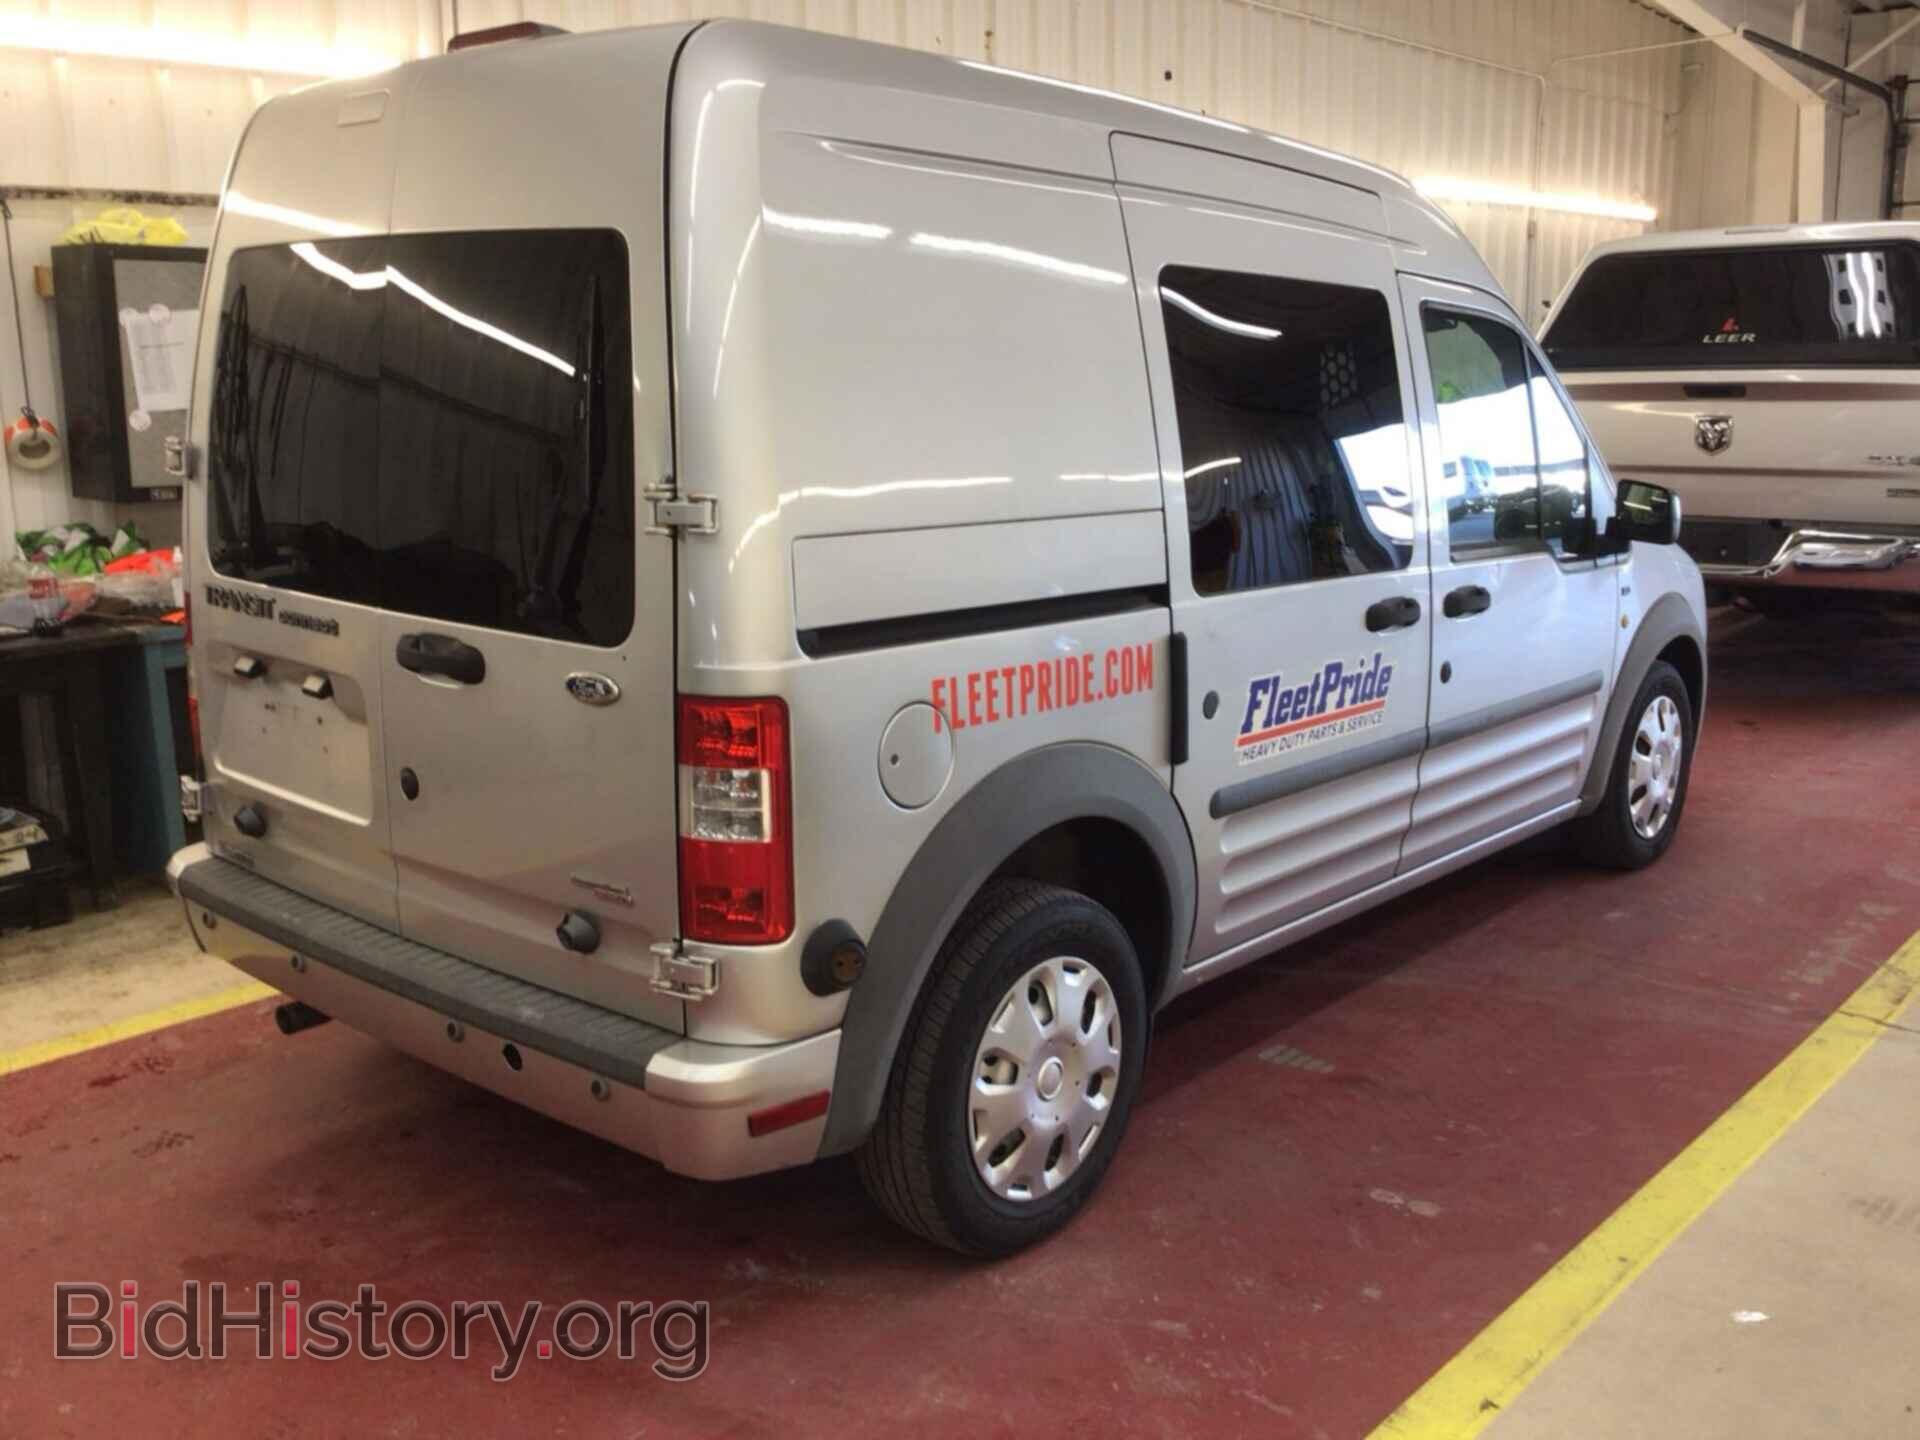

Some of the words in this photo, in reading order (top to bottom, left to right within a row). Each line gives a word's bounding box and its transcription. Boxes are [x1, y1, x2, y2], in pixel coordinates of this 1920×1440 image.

[1702, 332, 1757, 344] LEER
[205, 584, 276, 620] TRANSIT
[931, 642, 1154, 735] FLEETPRIDE.COM
[1240, 652, 1393, 735] FleetPride
[1242, 740, 1277, 762] HEAVY
[1279, 733, 1307, 751] DUTY
[1308, 724, 1338, 742] PARTS
[1345, 711, 1384, 733] SERVICE
